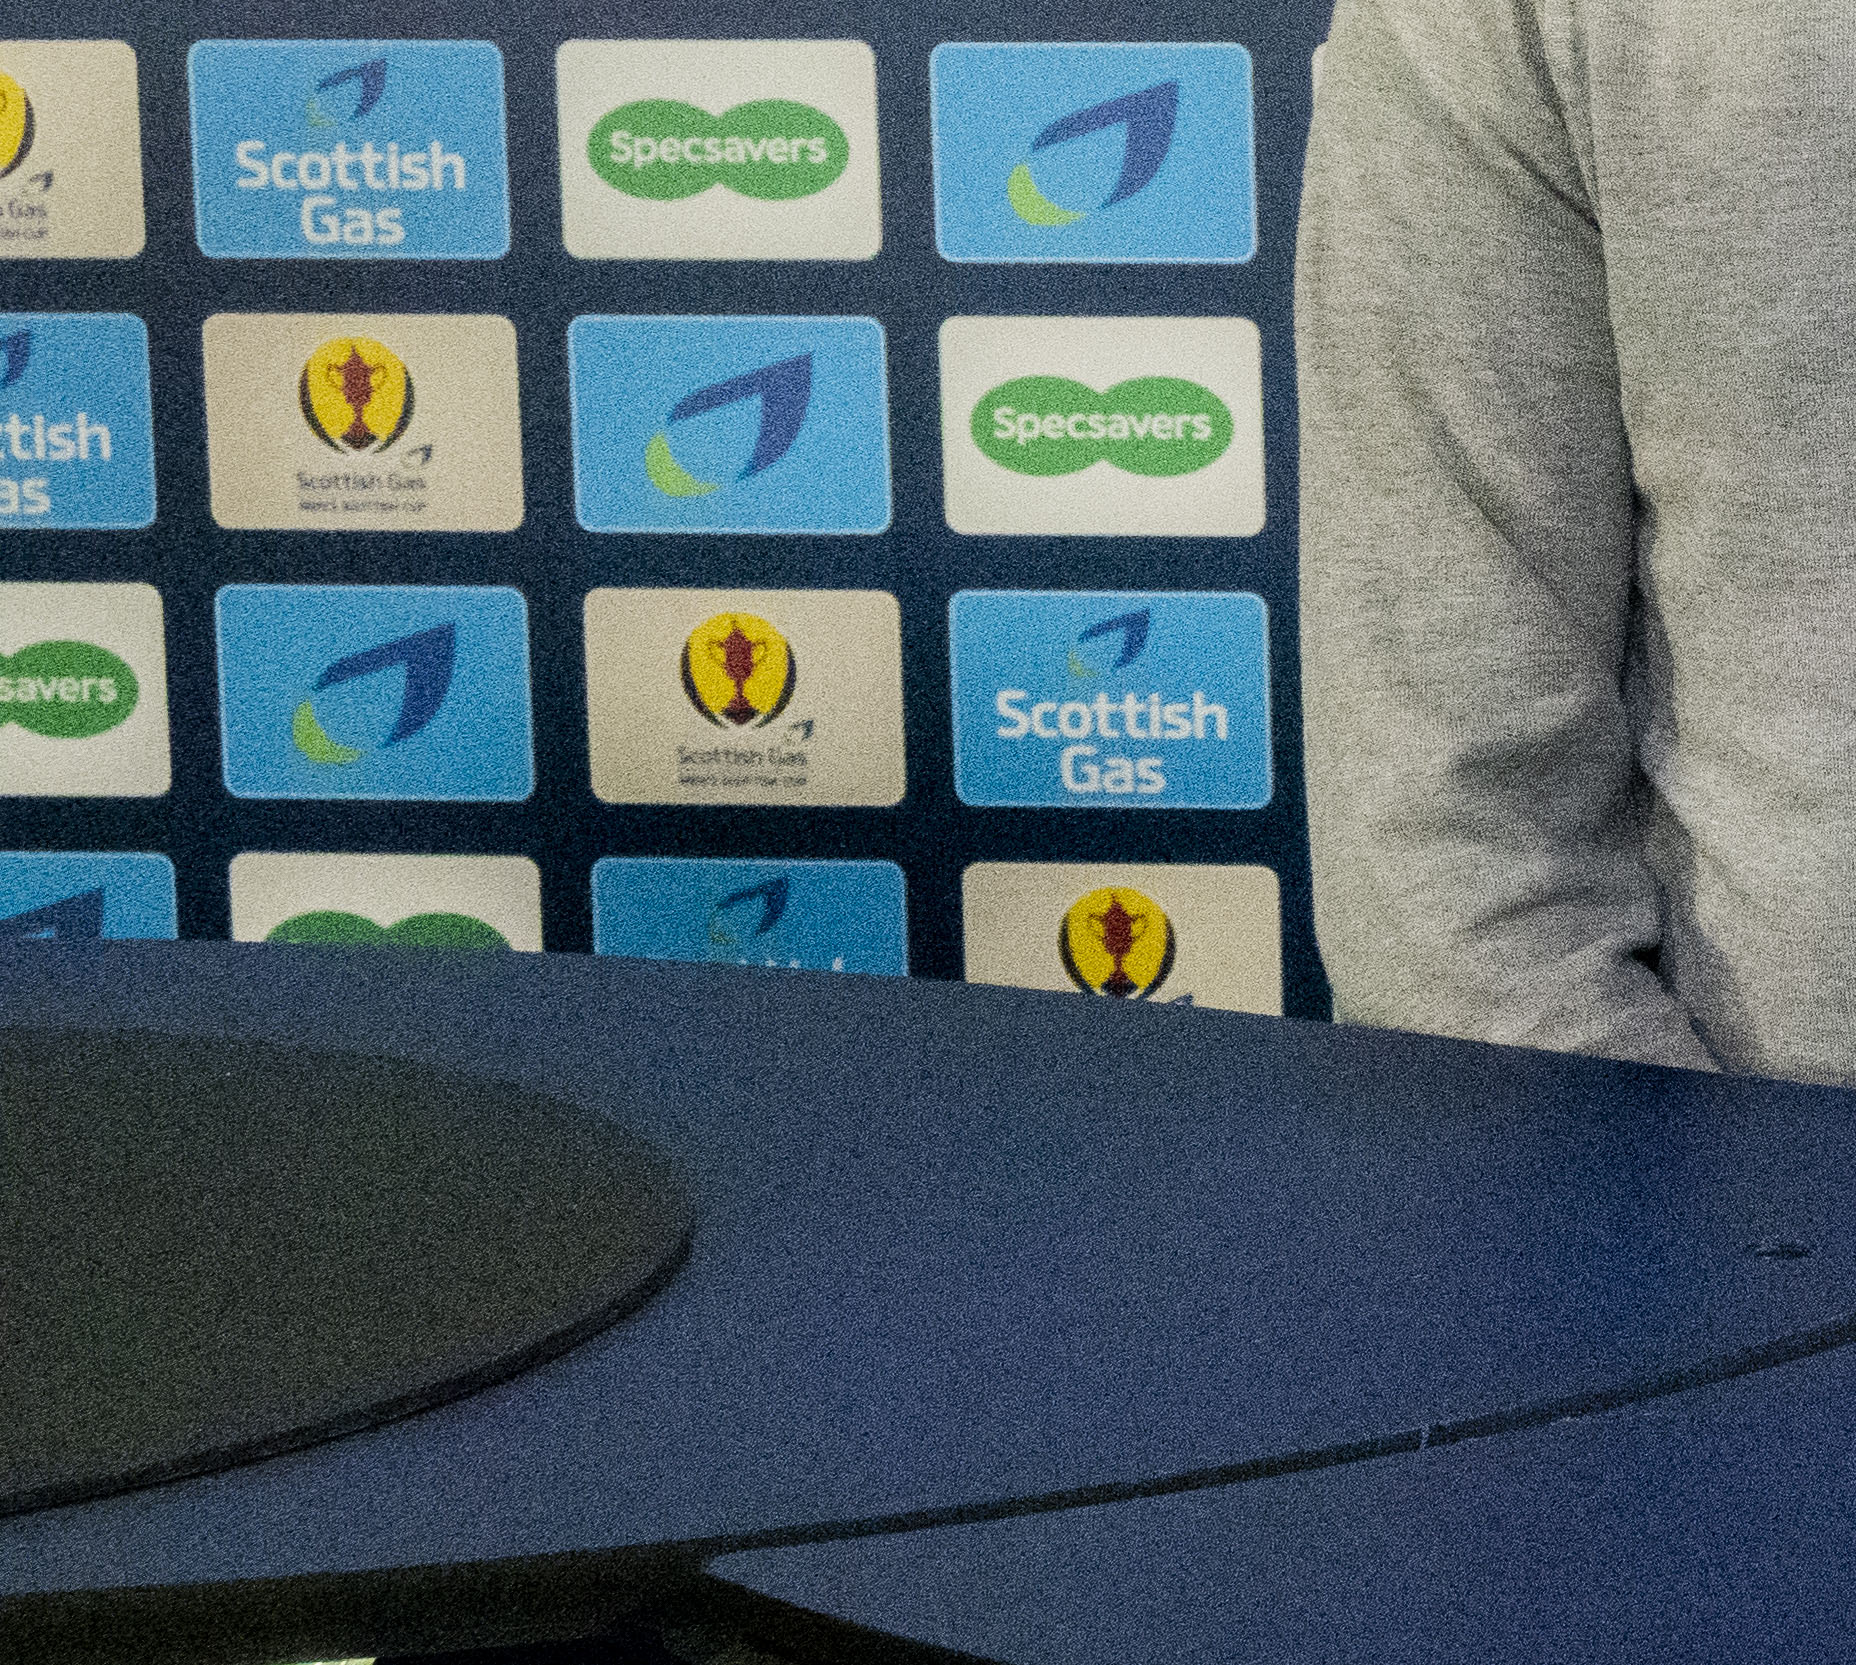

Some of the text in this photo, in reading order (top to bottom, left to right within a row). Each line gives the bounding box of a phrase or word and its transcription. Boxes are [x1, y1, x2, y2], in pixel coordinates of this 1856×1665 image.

[236, 140, 466, 190] Scottish
[609, 129, 830, 170] Specsavers
[300, 194, 405, 246] Gas
[0, 411, 113, 462] tish
[993, 405, 1213, 446] Specsavers
[0, 478, 52, 515] as
[295, 473, 426, 493] Scottish Gas
[995, 688, 1229, 740] Scottish
[676, 748, 807, 767] Scottish Gas
[1060, 743, 1166, 794] Gas
